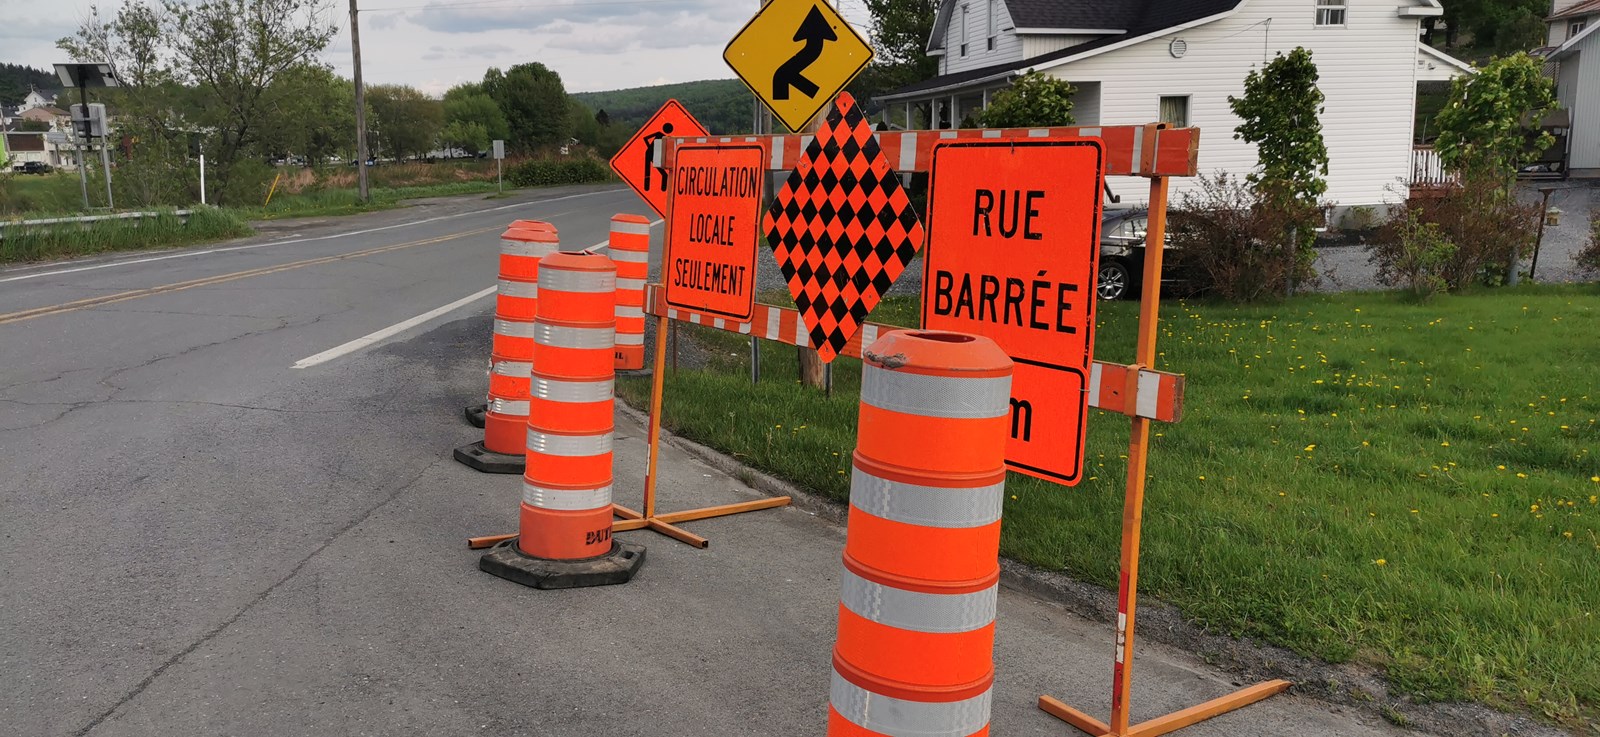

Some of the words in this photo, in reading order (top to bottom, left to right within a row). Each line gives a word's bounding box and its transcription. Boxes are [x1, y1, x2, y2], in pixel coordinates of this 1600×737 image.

[677, 166, 758, 198] CIRCULATION
[689, 213, 736, 247] LOCALE
[972, 189, 1046, 241] RUE
[674, 258, 746, 297] SEULEMENT
[934, 270, 1079, 334] BARRÉE
